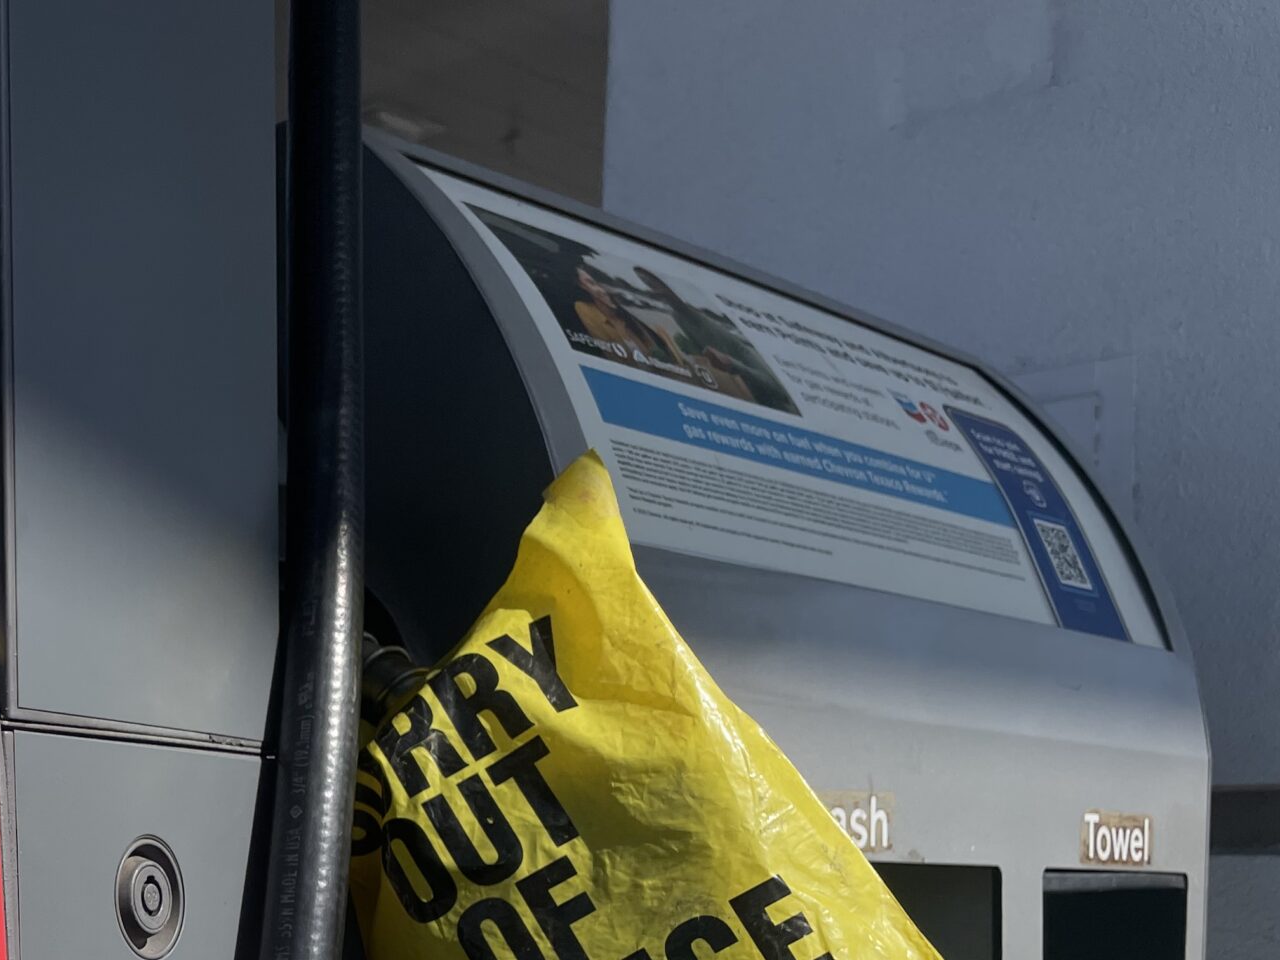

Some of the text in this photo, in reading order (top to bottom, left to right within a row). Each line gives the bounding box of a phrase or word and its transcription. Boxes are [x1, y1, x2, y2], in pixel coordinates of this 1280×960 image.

[678, 402, 709, 422] Save
[711, 412, 739, 430] even
[772, 431, 789, 444] on
[682, 424, 705, 440] gas
[707, 430, 755, 452] rewards
[756, 443, 782, 459] with
[822, 460, 868, 482] Chevron
[867, 471, 902, 491] Texaco
[351, 615, 579, 858] RRY
[285, 827, 302, 851] USA
[382, 736, 581, 924] OUT
[829, 795, 890, 849] ash
[1084, 812, 1150, 862] Towel
[280, 852, 300, 867] IN
[279, 870, 299, 905] MADE
